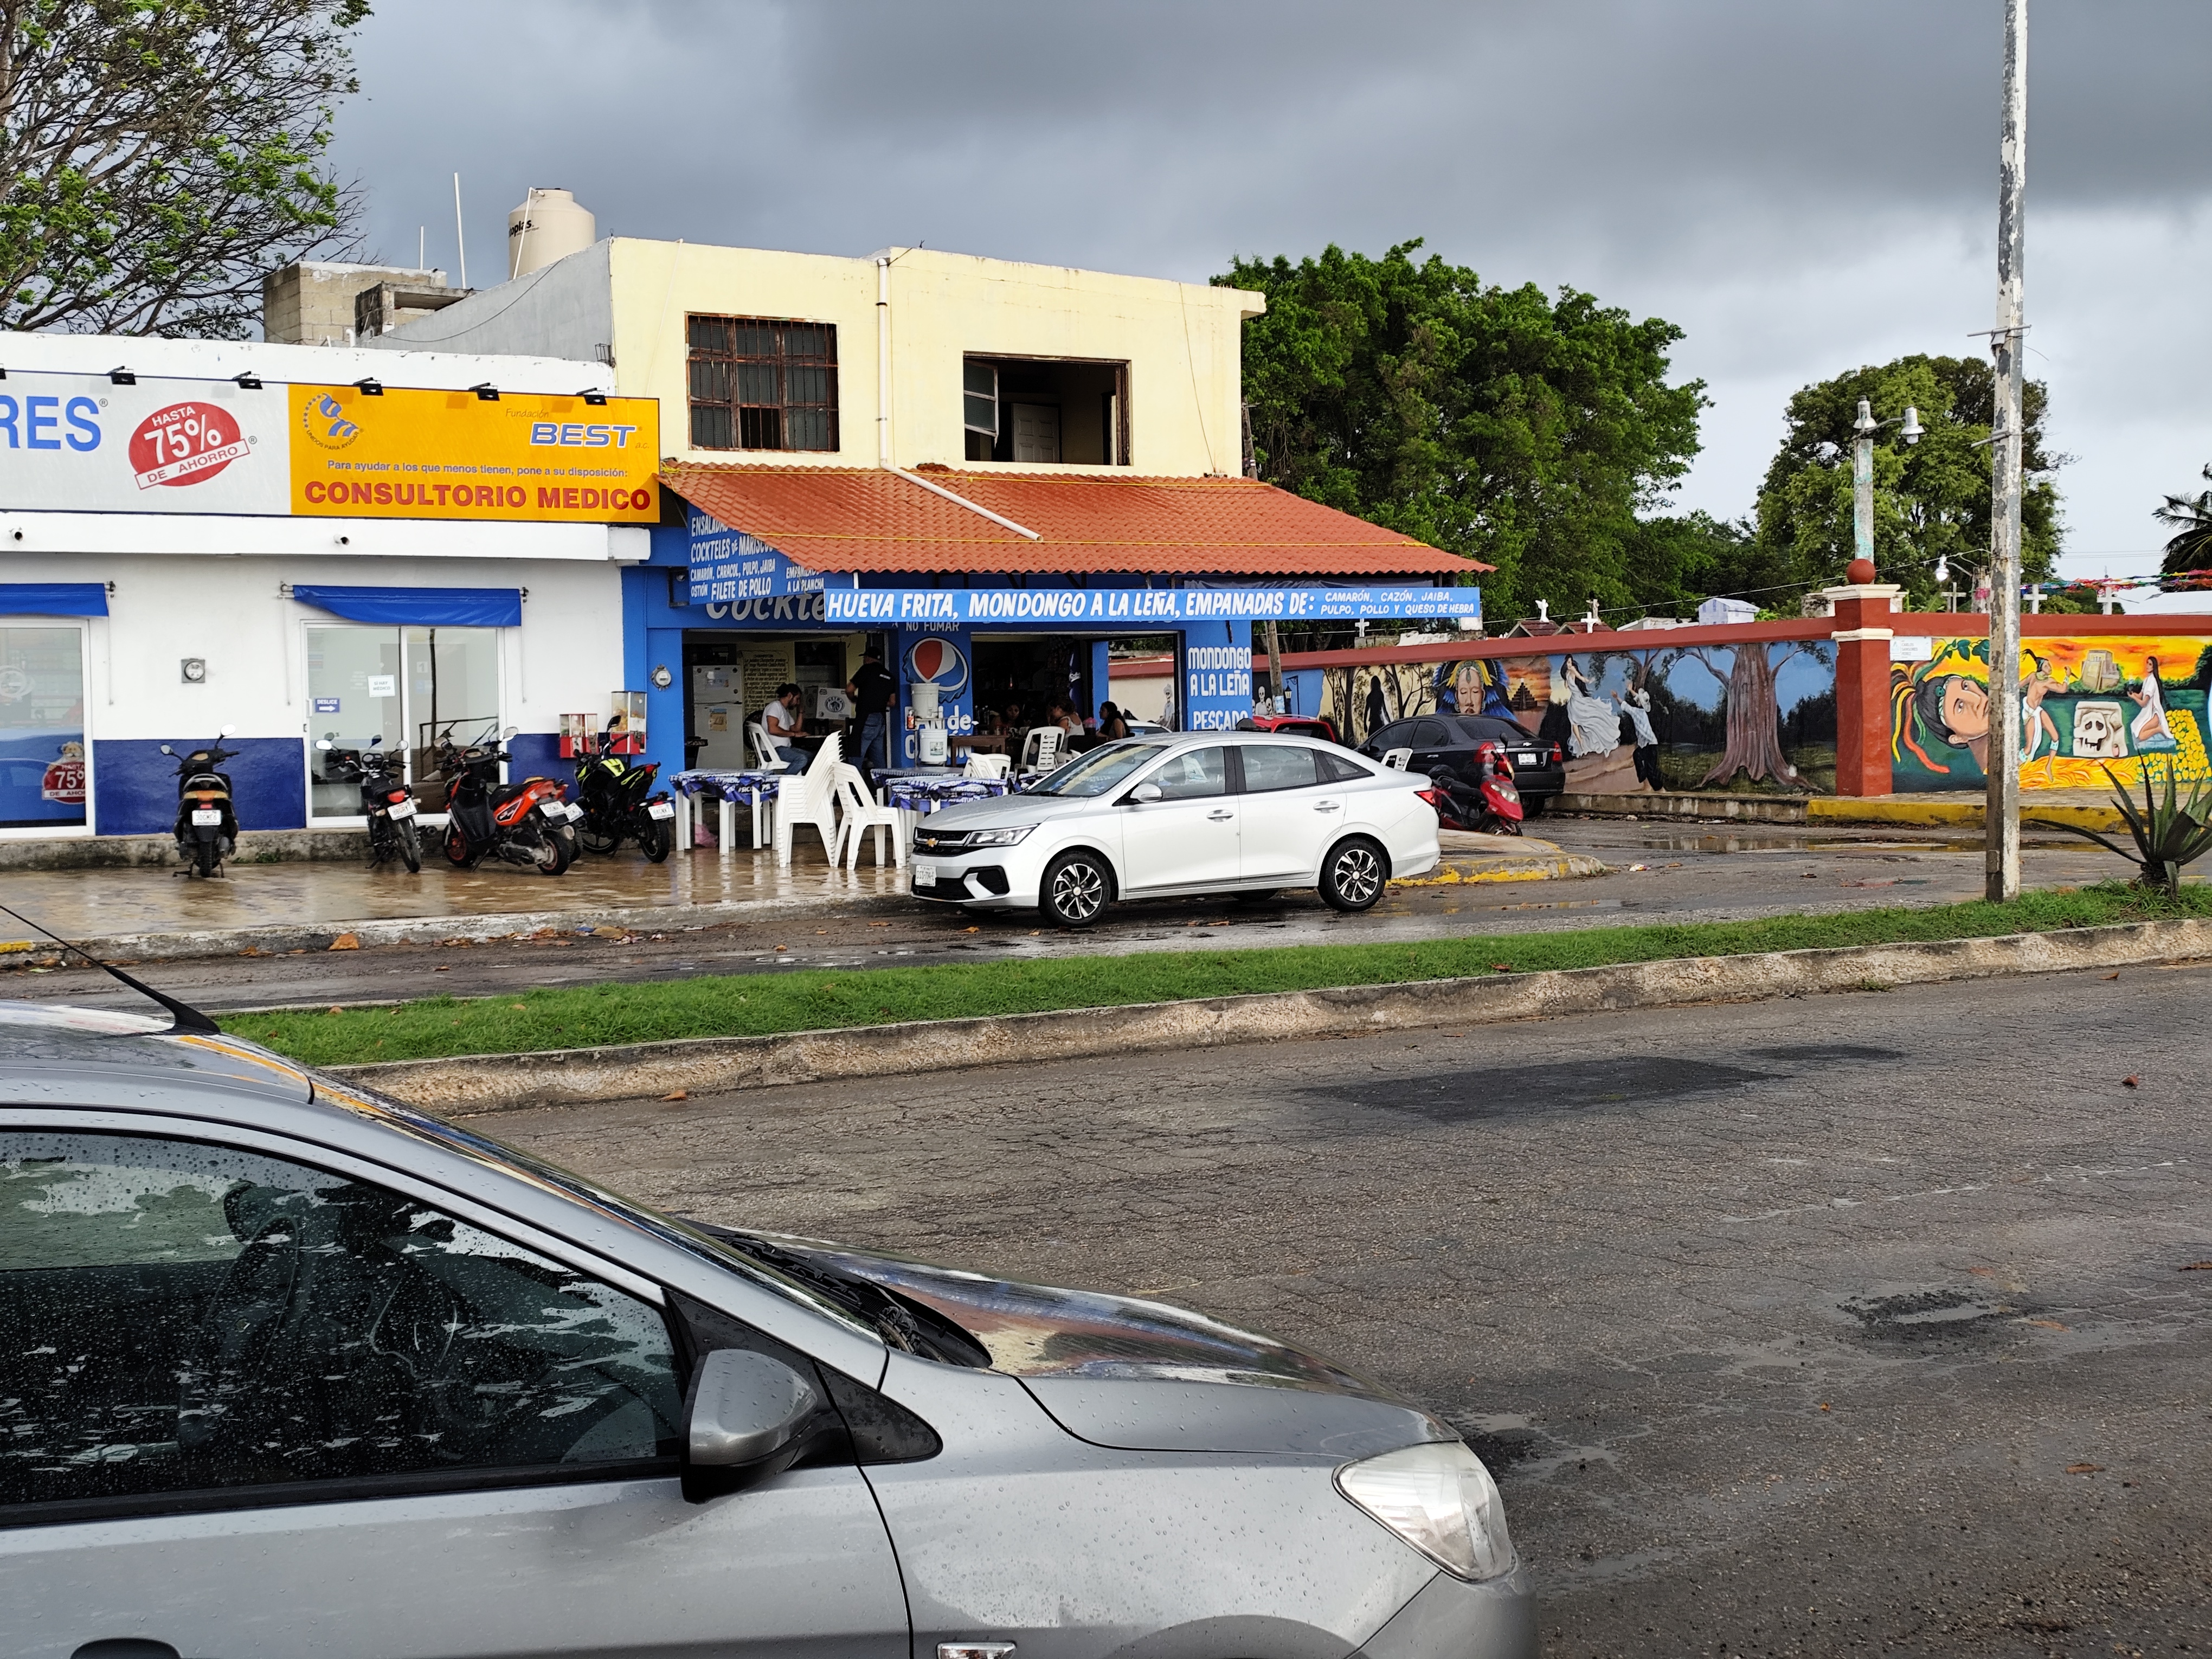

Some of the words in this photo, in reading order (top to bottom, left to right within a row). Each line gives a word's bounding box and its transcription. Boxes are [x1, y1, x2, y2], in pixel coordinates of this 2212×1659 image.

[152, 406, 195, 427] HASTA
[505, 408, 549, 418] Fundación
[144, 414, 221, 464] 75%
[306, 429, 324, 448] UNIDOS
[342, 431, 359, 449] AYUDAR
[530, 422, 636, 448] BEST
[147, 470, 168, 483] DE
[179, 446, 237, 473] AHORRO
[327, 460, 351, 470] Para
[355, 461, 390, 472] ayudar
[403, 462, 417, 471] los
[421, 465, 440, 473] que
[443, 465, 477, 474] menos
[480, 465, 514, 476] tienen,
[517, 467, 542, 476] pone
[568, 468, 628, 478] disposición:
[305, 480, 526, 507] CONSULTORIO
[538, 487, 651, 511] MEDICO
[691, 538, 730, 563] COCKTELES
[690, 564, 715, 582] CAMARÓN,
[716, 563, 741, 578] CARACOL,
[743, 560, 759, 576] PULPO,
[760, 558, 775, 574] JAIBA
[691, 582, 708, 597] OSTIÓN
[711, 581, 736, 601] FILETE
[739, 580, 747, 597] DE
[749, 577, 771, 597] POLLO
[787, 581, 791, 593] A
[793, 580, 800, 593] LA
[801, 577, 824, 592] PLANCHA
[1325, 590, 1373, 603] CAMARÓN,
[1381, 589, 1416, 602] CAZÓN,
[827, 593, 895, 618] HUEVA
[901, 593, 959, 620] FRITA,
[968, 593, 1085, 617] MONDONGO
[1090, 593, 1103, 616] A
[1108, 593, 1128, 616] LA
[1133, 591, 1180, 619] LEÑA,
[1186, 591, 1284, 615] EMPANADAS
[1289, 592, 1315, 615] DE:
[1321, 605, 1354, 615] PULPO,
[1360, 605, 1389, 614] POLLO
[1394, 604, 1401, 614] Y
[1405, 604, 1435, 615] QUESO
[1437, 604, 1448, 614] DE
[1449, 603, 1474, 614] HEBRA
[906, 622, 918, 631] NO
[924, 622, 960, 632] FUMAR
[1188, 647, 1251, 670] MONDONGO
[1190, 674, 1198, 696] A
[1200, 673, 1216, 696] LA
[1219, 670, 1250, 696] LEÑA
